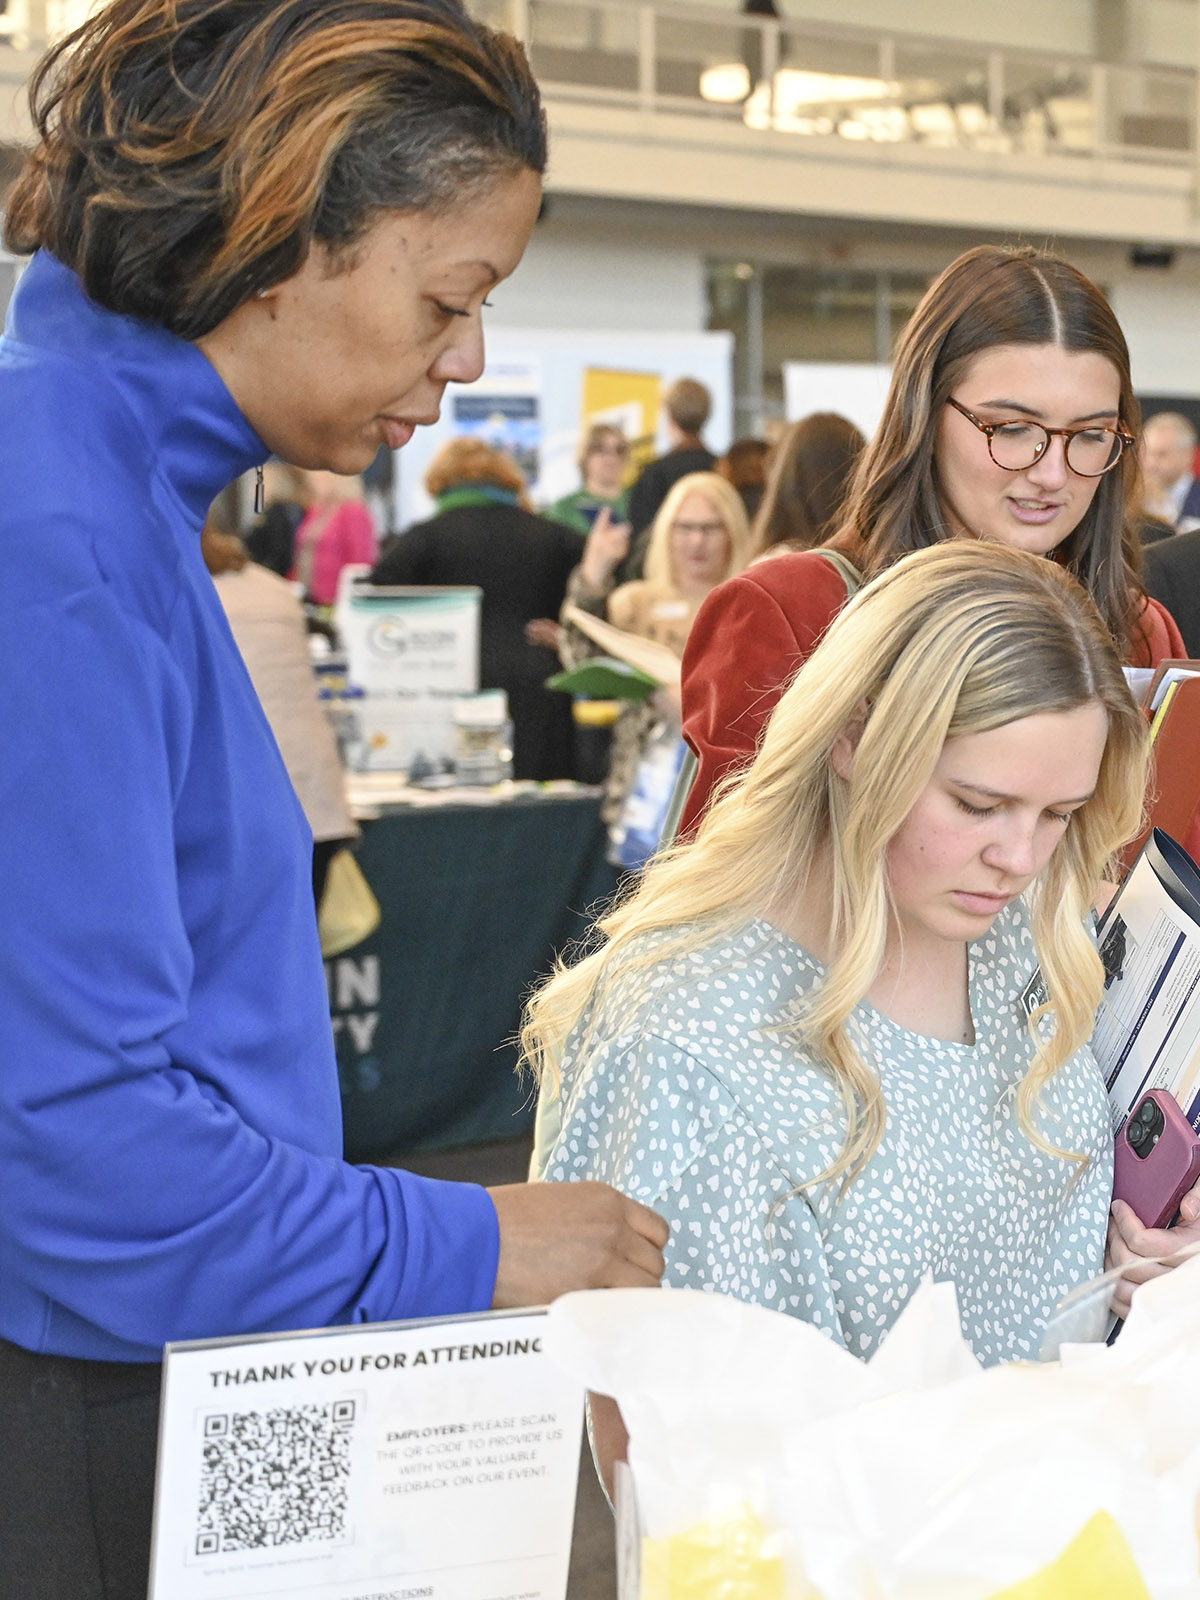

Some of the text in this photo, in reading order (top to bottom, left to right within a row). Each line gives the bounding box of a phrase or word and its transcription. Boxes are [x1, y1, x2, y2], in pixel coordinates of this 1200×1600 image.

[209, 1362, 296, 1388] THANK
[303, 1356, 355, 1377] YOU
[360, 1351, 407, 1372] FOR
[386, 1412, 558, 1443] EMPLOYERS: PLEASE SCAN
[425, 1440, 465, 1457] CODE
[467, 1436, 486, 1450] TO
[487, 1431, 543, 1448] PROVIDE
[546, 1428, 564, 1441] US
[399, 1448, 538, 1476] WITH YOUR VALUABLE
[382, 1477, 449, 1496] FEEDBACK
[453, 1474, 474, 1488] ON
[477, 1470, 504, 1485] OUR
